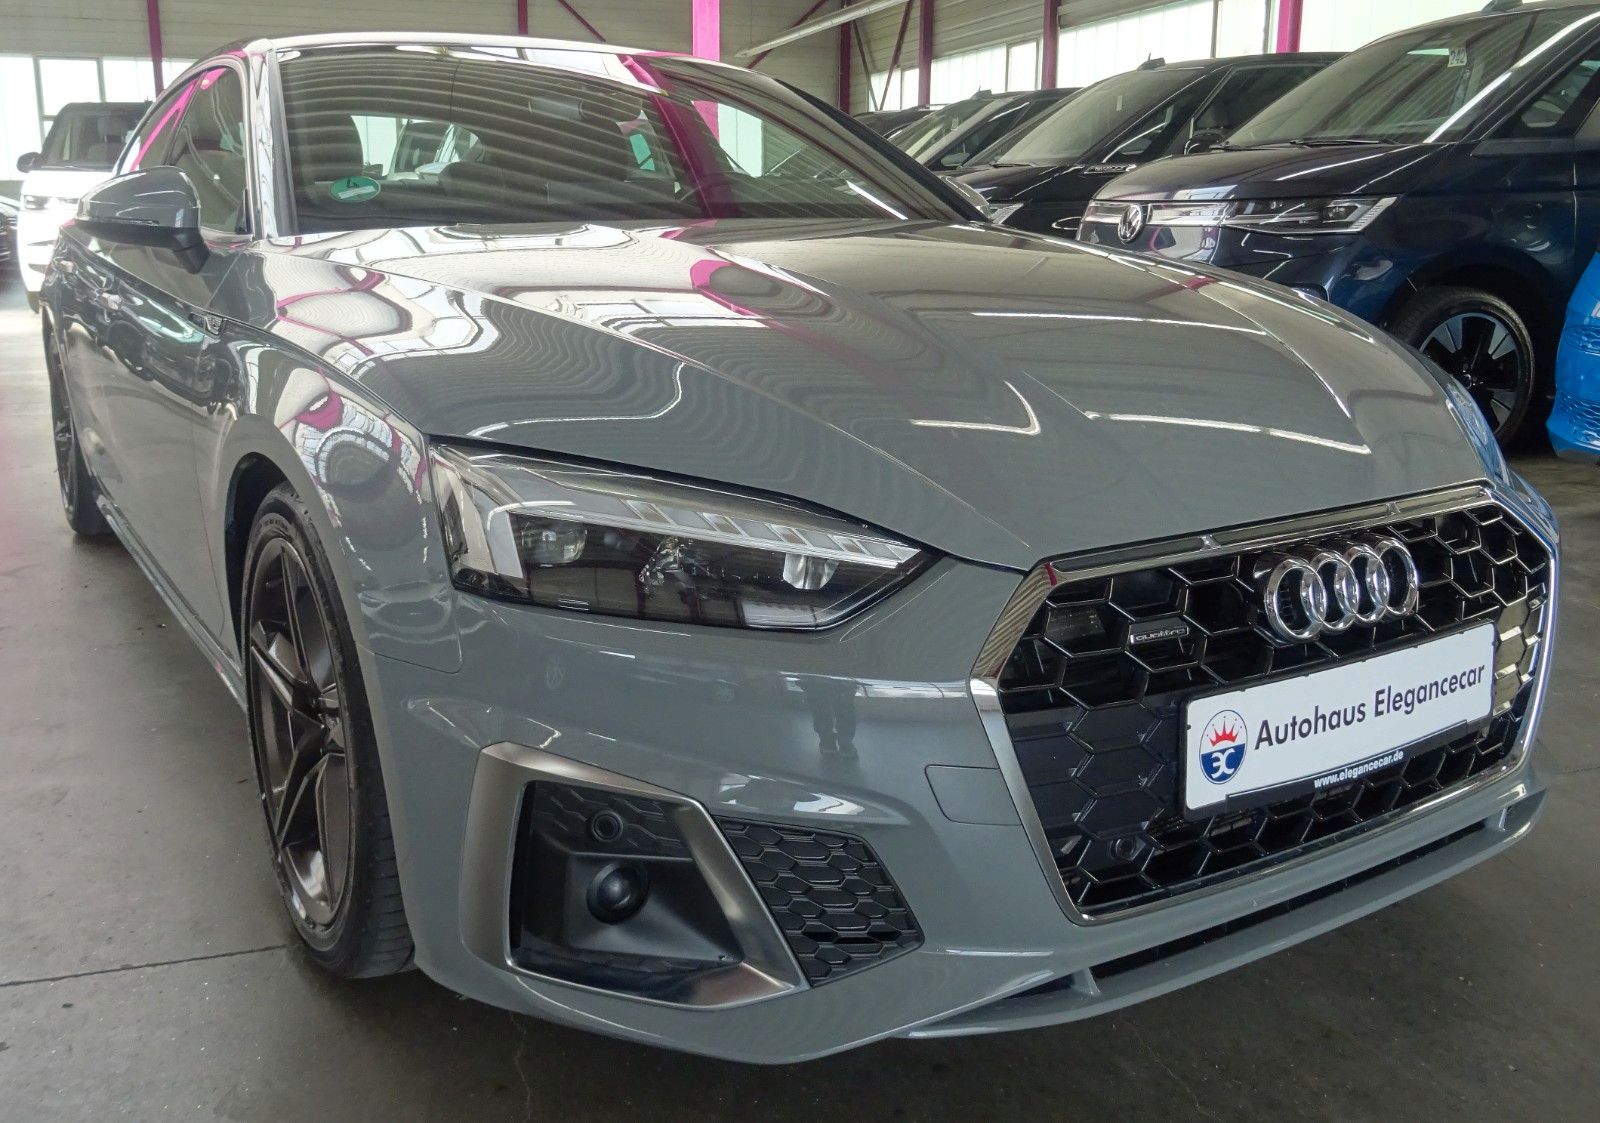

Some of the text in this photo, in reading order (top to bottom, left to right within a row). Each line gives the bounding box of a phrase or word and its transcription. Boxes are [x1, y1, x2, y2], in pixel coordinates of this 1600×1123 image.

[1254, 664, 1485, 750] Autohaus Elegancecar
[1313, 750, 1404, 788] www.elegancecar.de
